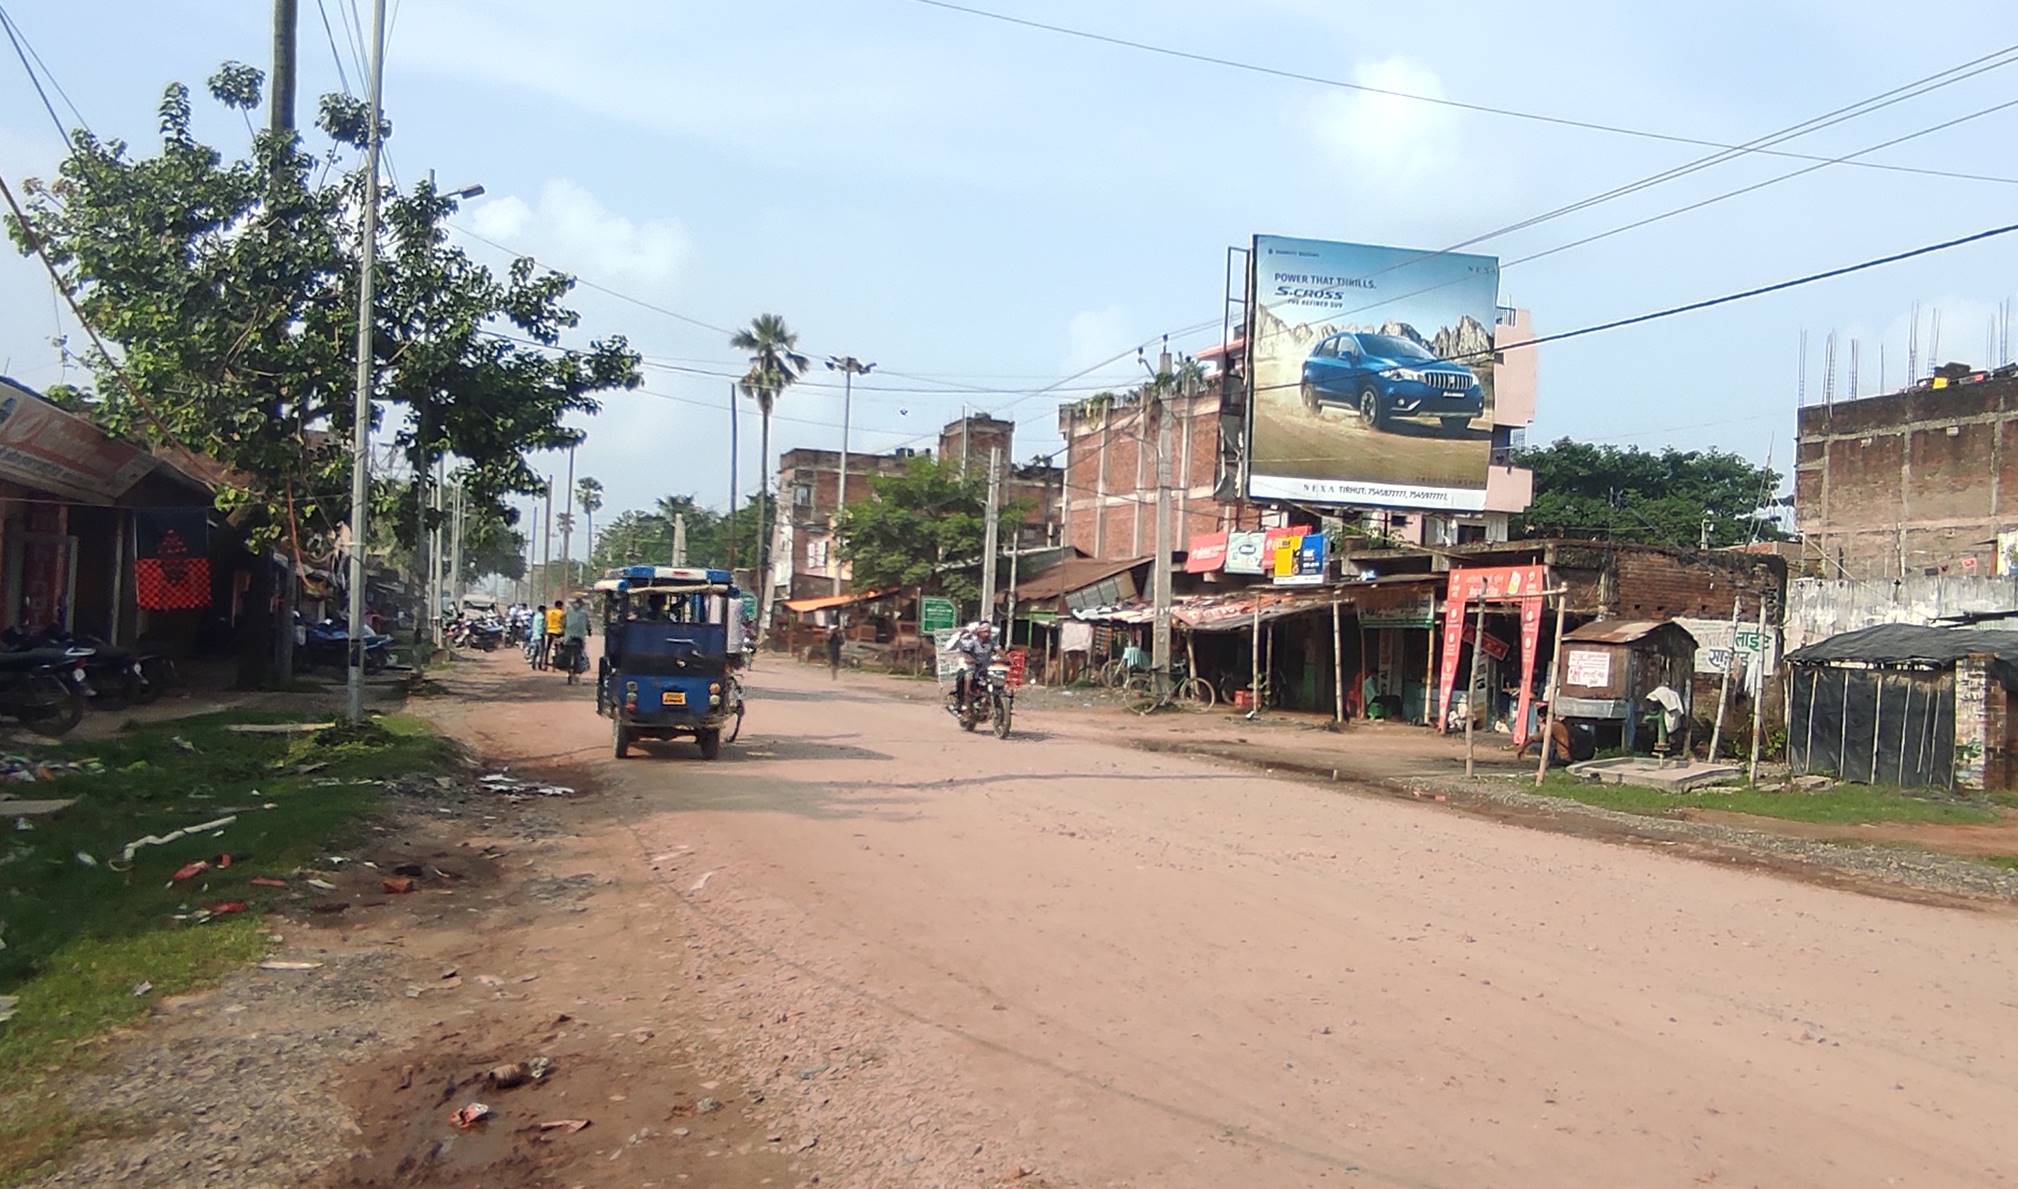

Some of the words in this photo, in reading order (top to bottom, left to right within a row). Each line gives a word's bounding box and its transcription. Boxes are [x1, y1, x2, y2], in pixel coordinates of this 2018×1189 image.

[1274, 273, 1309, 285] POWER
[1311, 275, 1334, 286] THAT
[1303, 484, 1335, 493] NEXA
